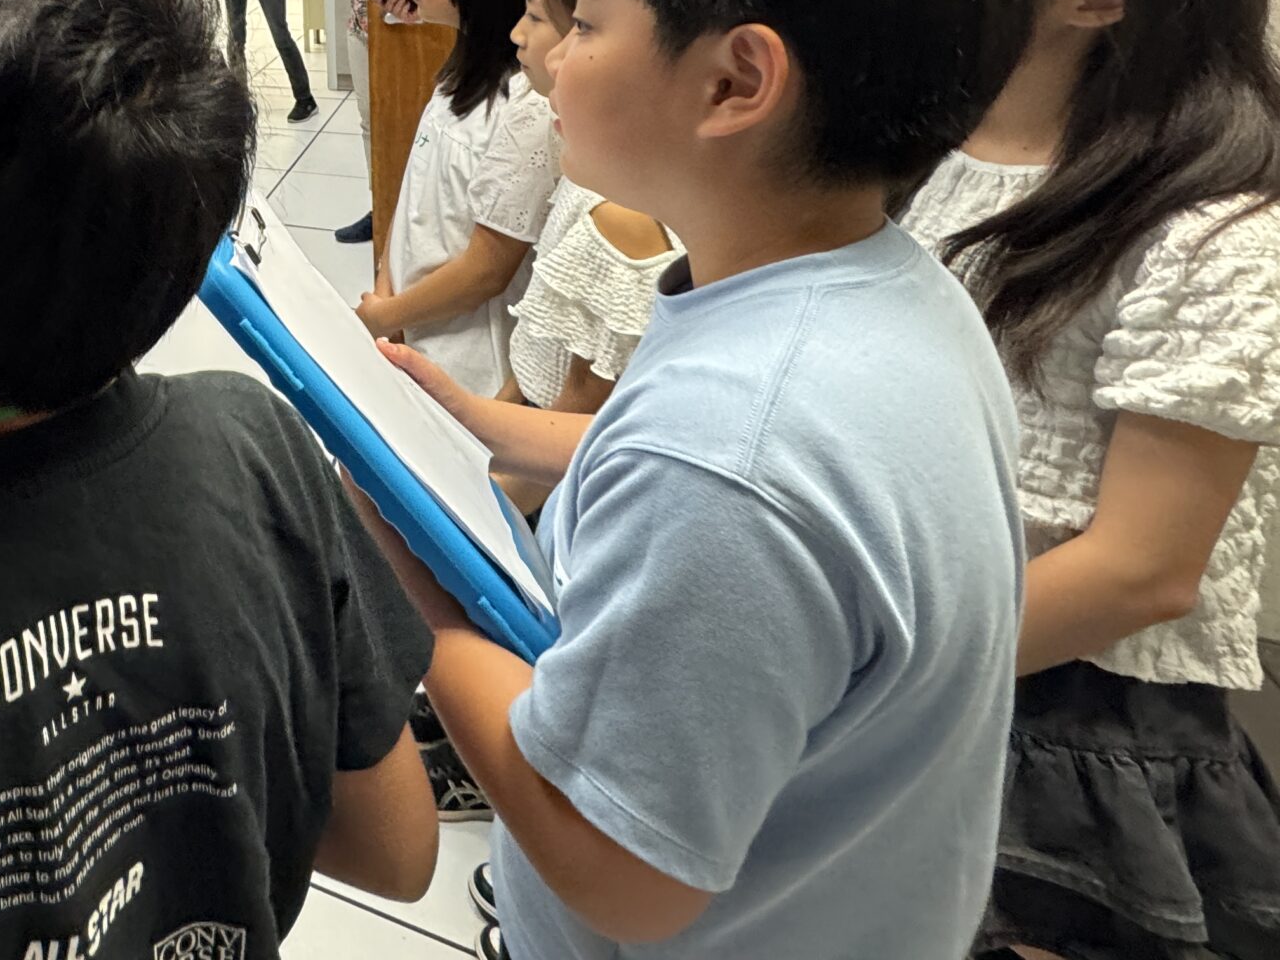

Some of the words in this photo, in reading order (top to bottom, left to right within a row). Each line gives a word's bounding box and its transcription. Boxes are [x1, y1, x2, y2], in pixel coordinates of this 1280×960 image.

[0, 785, 44, 804] express
[46, 764, 66, 791] their
[68, 732, 116, 772] originality
[118, 729, 126, 739] is
[129, 724, 148, 736] the
[150, 711, 177, 735] great
[178, 706, 215, 721] legacy
[7, 807, 23, 823] All
[75, 759, 107, 789] legacy
[110, 744, 130, 765] that
[135, 725, 193, 755] transcends
[40, 820, 63, 841] that
[64, 776, 111, 824] transcends
[165, 745, 191, 764] what
[19, 850, 33, 862] to
[38, 844, 64, 862] truly
[66, 821, 84, 849] own
[85, 805, 99, 825] the
[102, 779, 141, 809] concept
[145, 772, 157, 786] of
[161, 763, 218, 781] Originality
[35, 869, 50, 883] to
[82, 801, 132, 856] generations
[133, 792, 151, 808] not
[153, 784, 174, 803] just
[177, 782, 189, 793] to
[40, 891, 61, 904] but
[63, 883, 76, 899] to
[103, 827, 122, 852] their
[87, 861, 145, 957] STAR
